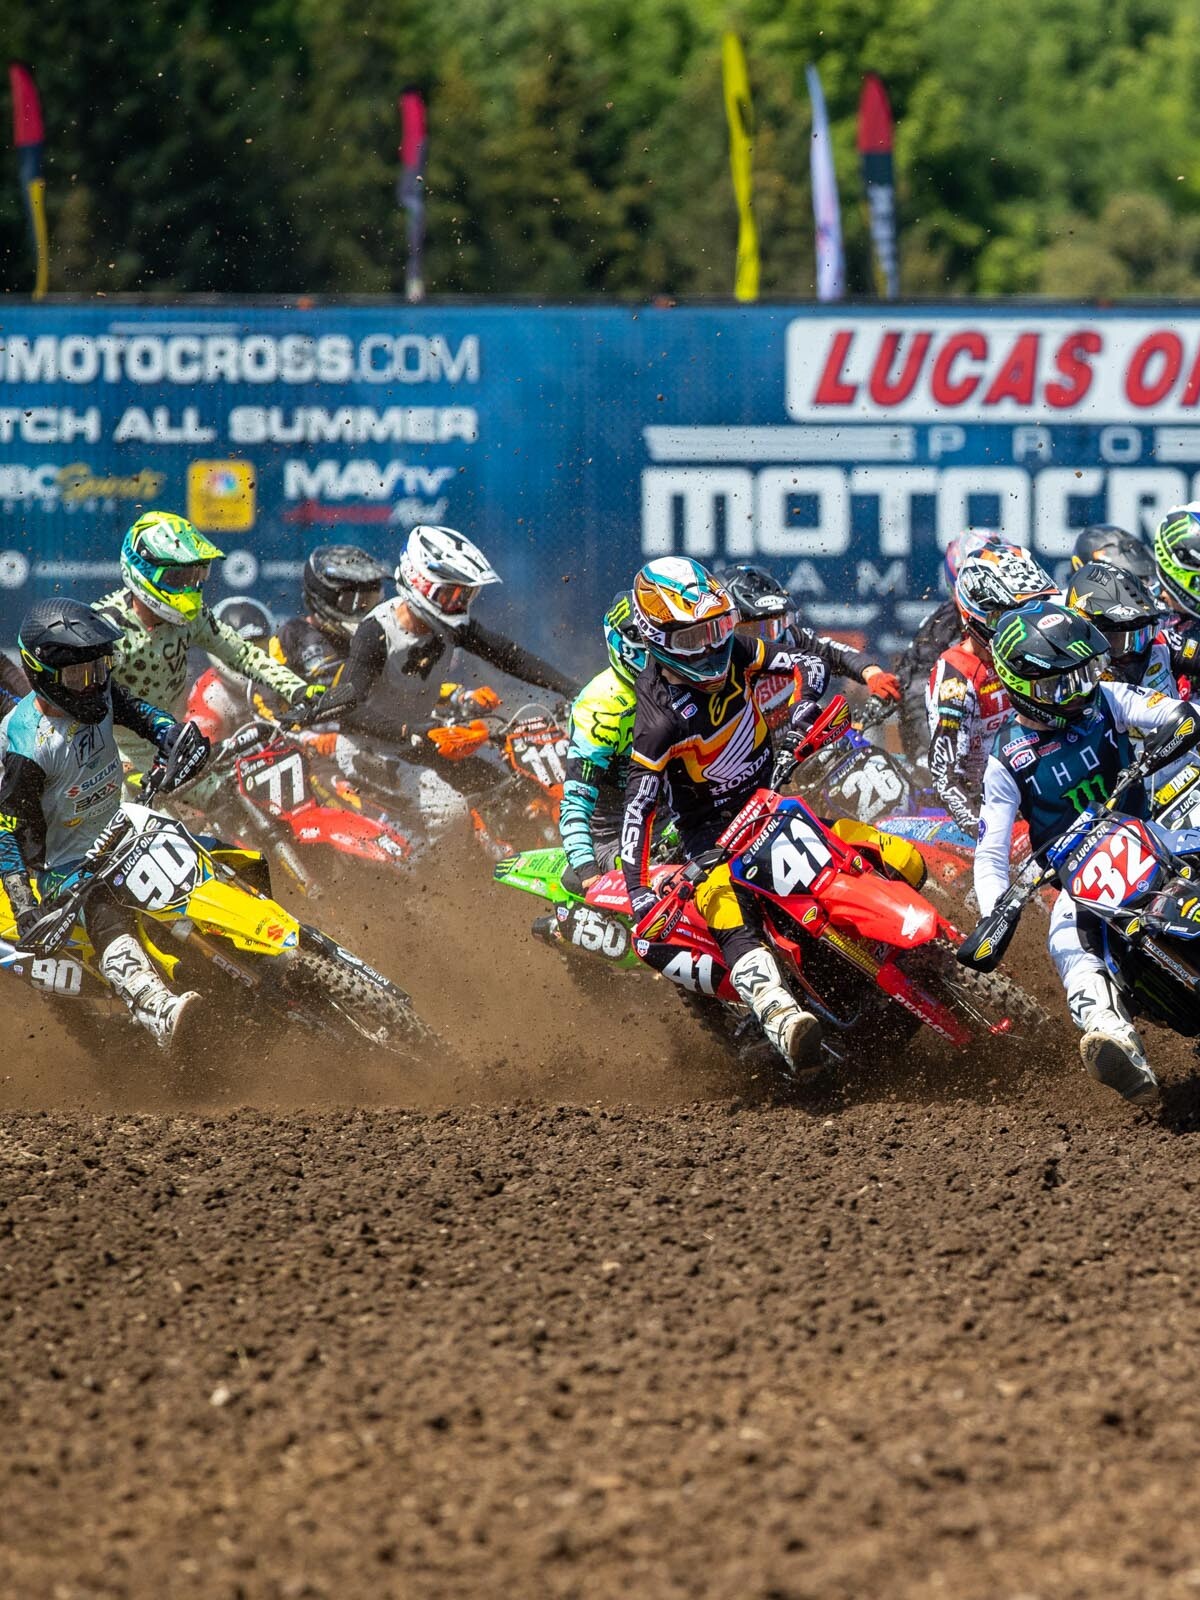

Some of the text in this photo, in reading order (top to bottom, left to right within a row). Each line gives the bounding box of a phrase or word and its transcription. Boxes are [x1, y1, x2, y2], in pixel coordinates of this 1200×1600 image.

[0, 333, 480, 384] MOTOCROSS.COM
[814, 330, 1102, 407] LUCAS
[0, 405, 479, 445] TCH ALL SUMMER
[929, 426, 1142, 463] PRO
[1041, 615, 1061, 628] BELL
[822, 718, 851, 747] CYCRA
[81, 758, 120, 792] SUZUKI
[173, 744, 206, 789] ACERBIS
[254, 752, 305, 815] 77
[709, 748, 770, 796] HONDA
[621, 774, 660, 865] ASTARS
[719, 796, 759, 845] RENTHAL
[749, 818, 780, 856] LUCAS OIL
[120, 845, 147, 877] LUCAS
[770, 814, 833, 897] 41
[1075, 824, 1110, 862] LUCAS OIL
[125, 823, 199, 912] 90
[1082, 824, 1157, 908] 32
[43, 912, 76, 955] ACERBIS
[660, 909, 684, 941] CYCRA
[31, 956, 83, 996] 90
[661, 950, 716, 995] 41
[892, 992, 956, 1042] DUNLOP
